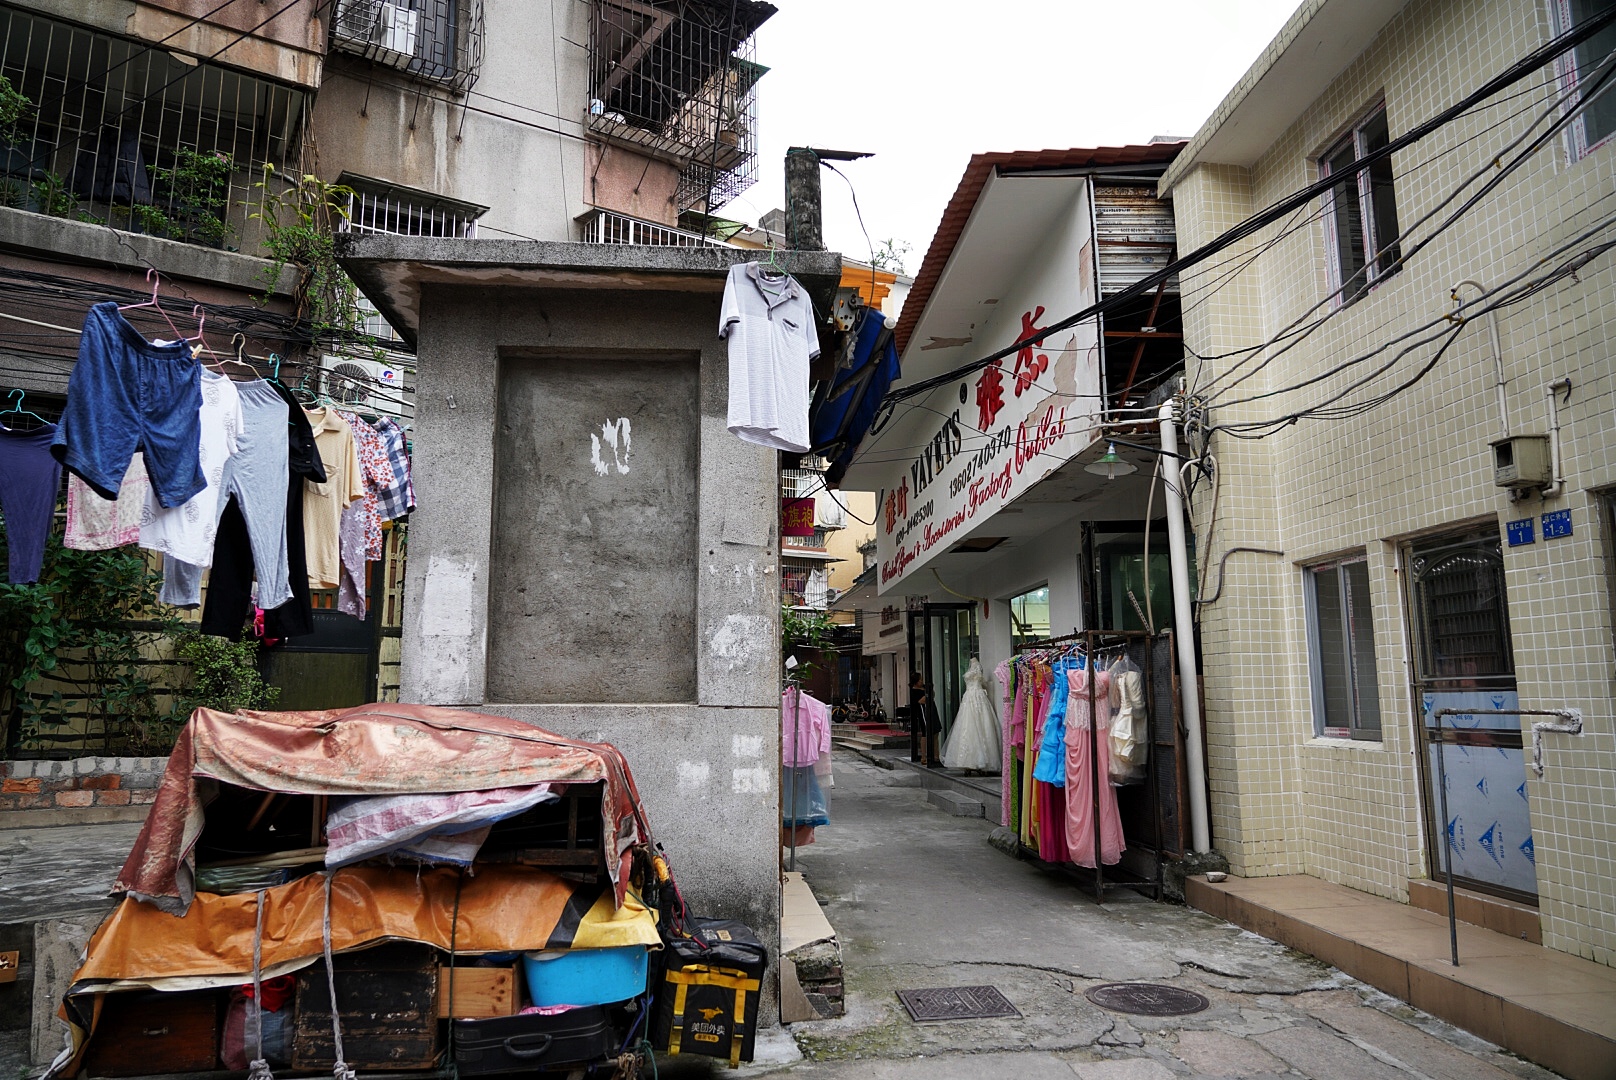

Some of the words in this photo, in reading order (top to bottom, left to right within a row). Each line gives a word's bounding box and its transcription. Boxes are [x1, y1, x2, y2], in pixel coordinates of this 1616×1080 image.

[911, 409, 962, 499] YAYETS
[949, 425, 1011, 499] 13602740370
[968, 458, 1012, 518] Factory
[1015, 405, 1065, 475] Outlet
[1518, 531, 1523, 542] 1
[1549, 524, 1564, 535] 1-2
[691, 1022, 726, 1036] 美团外卖
